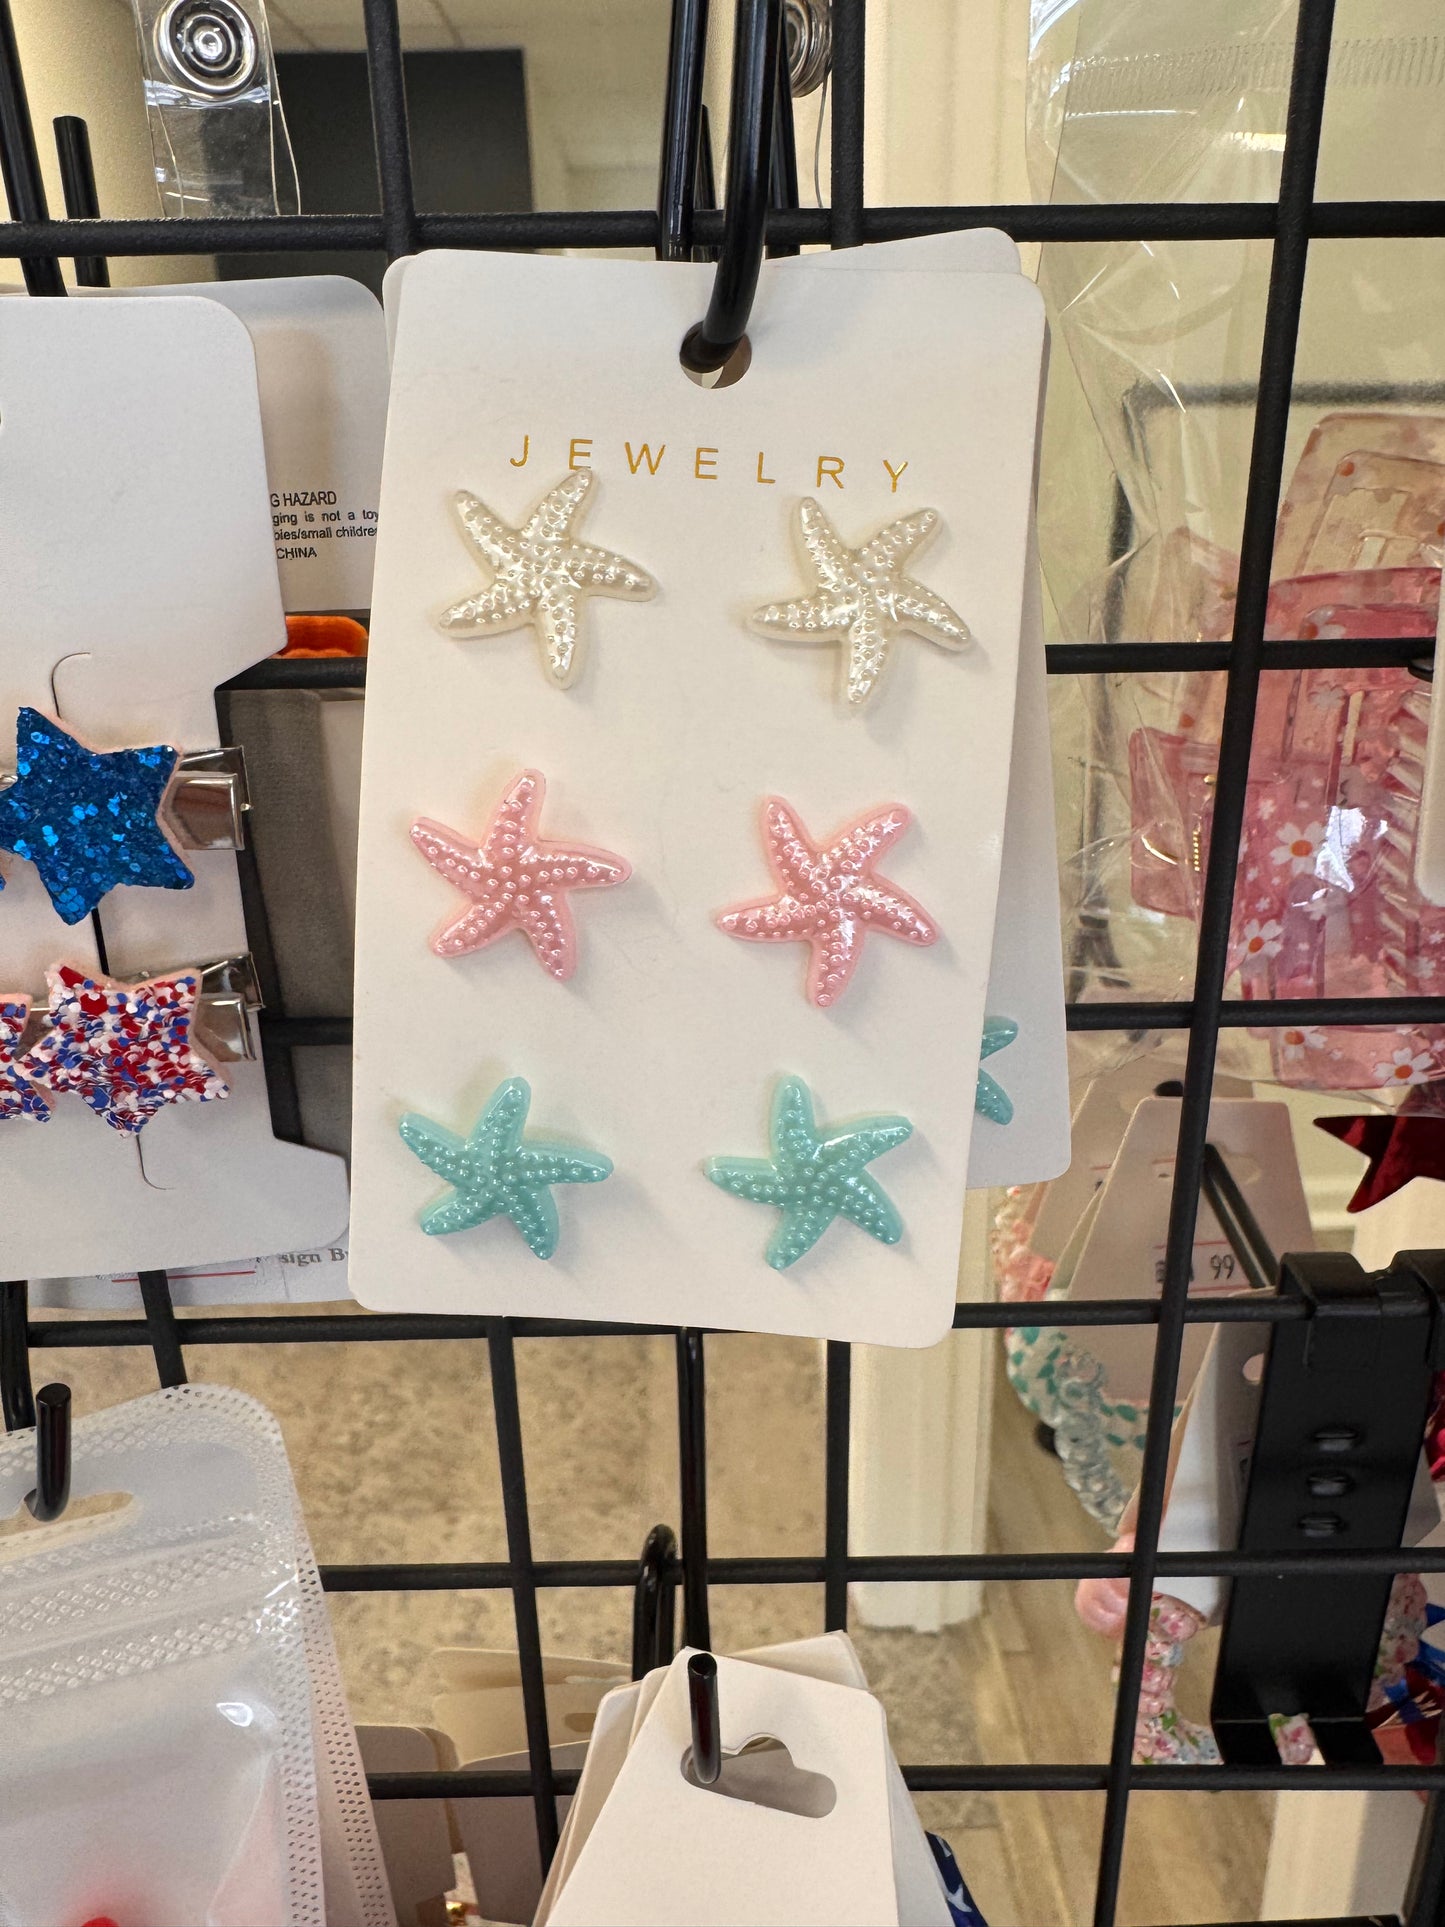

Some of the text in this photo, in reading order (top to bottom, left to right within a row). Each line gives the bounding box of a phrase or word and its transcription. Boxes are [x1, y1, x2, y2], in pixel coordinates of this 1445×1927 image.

[509, 434, 909, 493] JEWELRY
[283, 491, 337, 506] HAZARD
[273, 512, 298, 526] ging
[304, 510, 315, 522] is
[322, 510, 341, 521] not
[348, 511, 355, 520] a
[276, 547, 317, 559] CHINA
